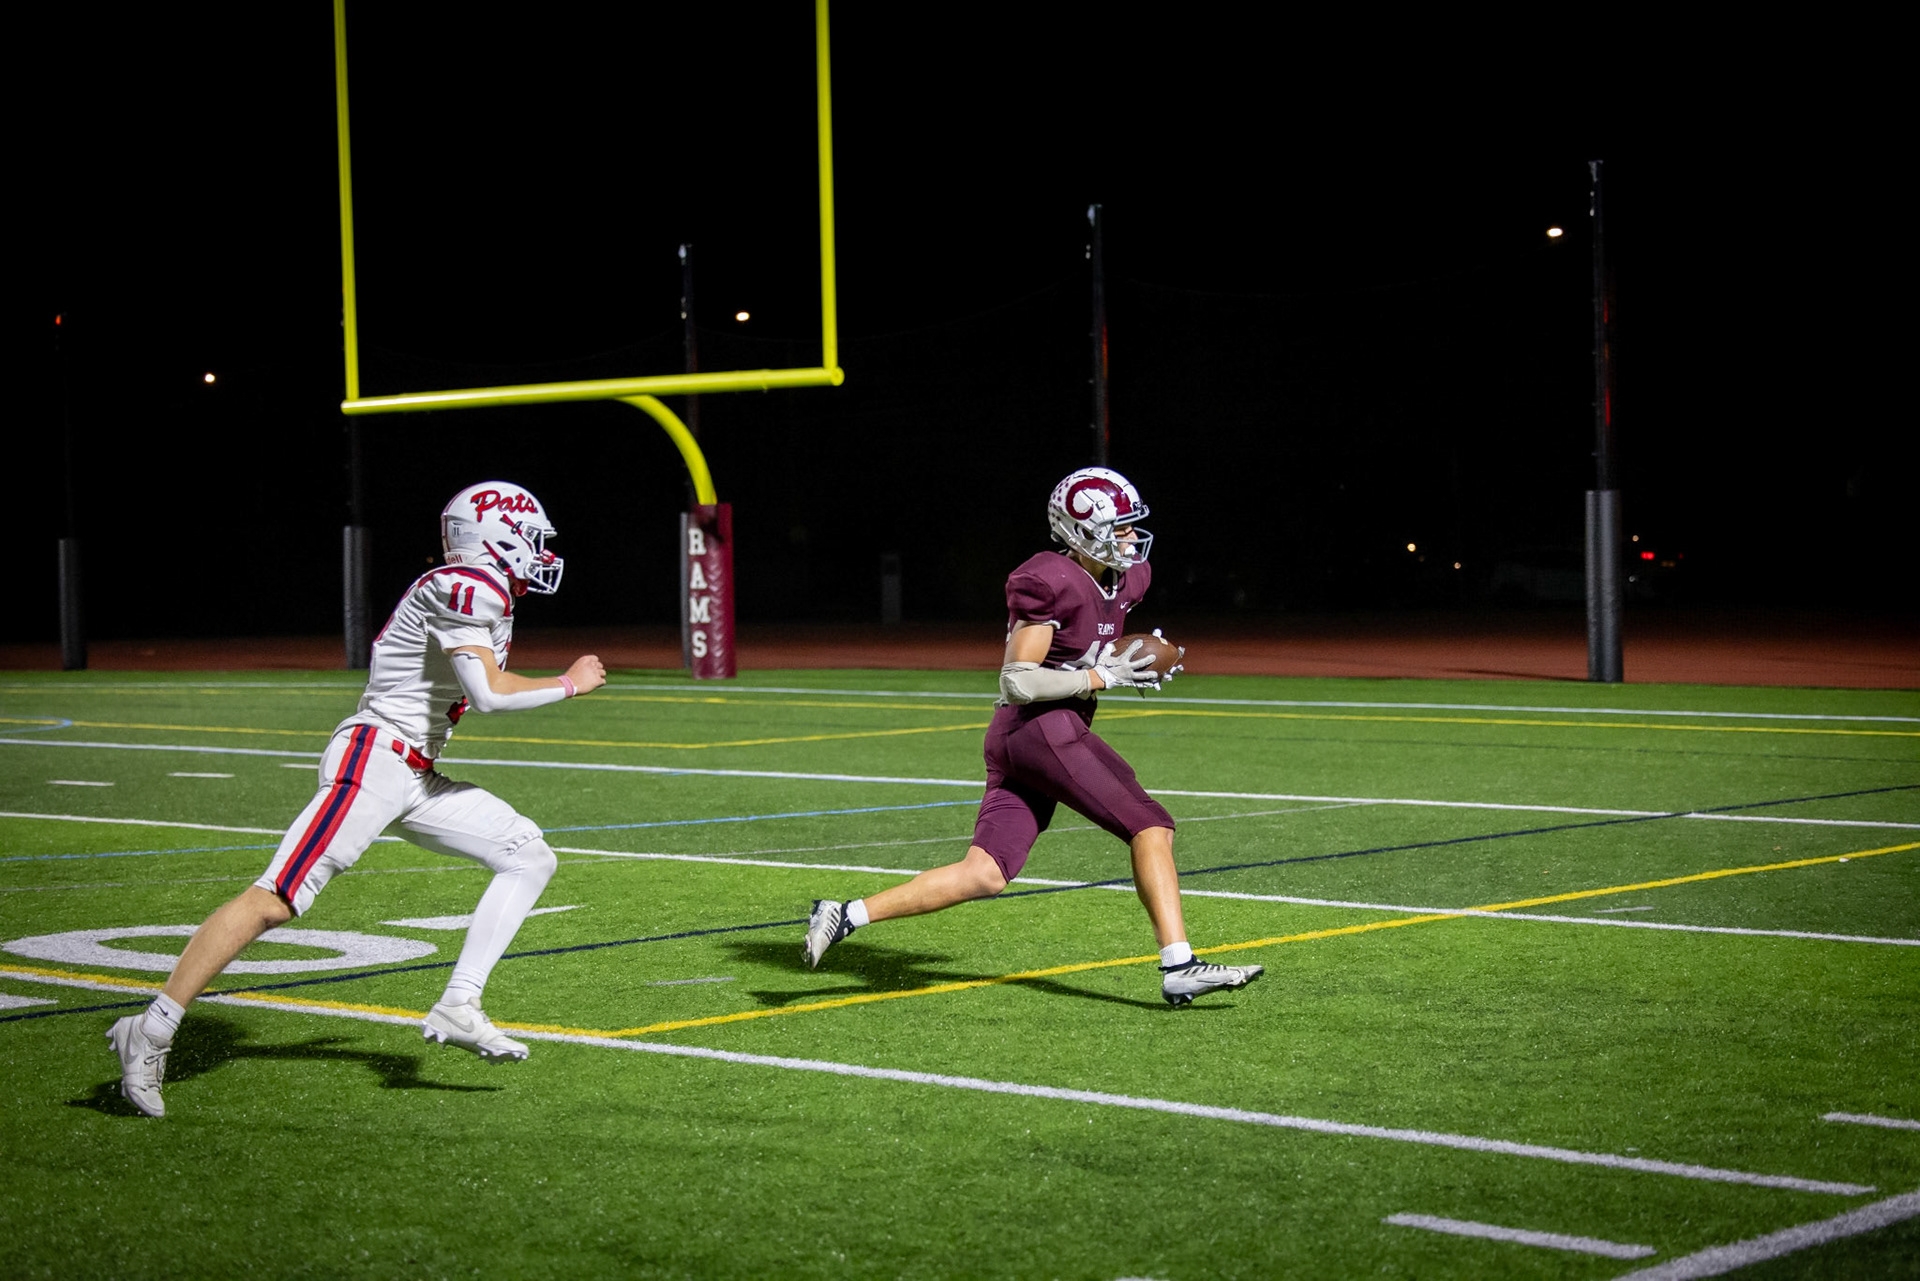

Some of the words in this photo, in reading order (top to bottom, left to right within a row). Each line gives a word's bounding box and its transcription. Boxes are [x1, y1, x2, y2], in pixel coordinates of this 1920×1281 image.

[470, 490, 538, 522] Pats
[448, 582, 475, 616] 11
[688, 528, 711, 657] RAMS
